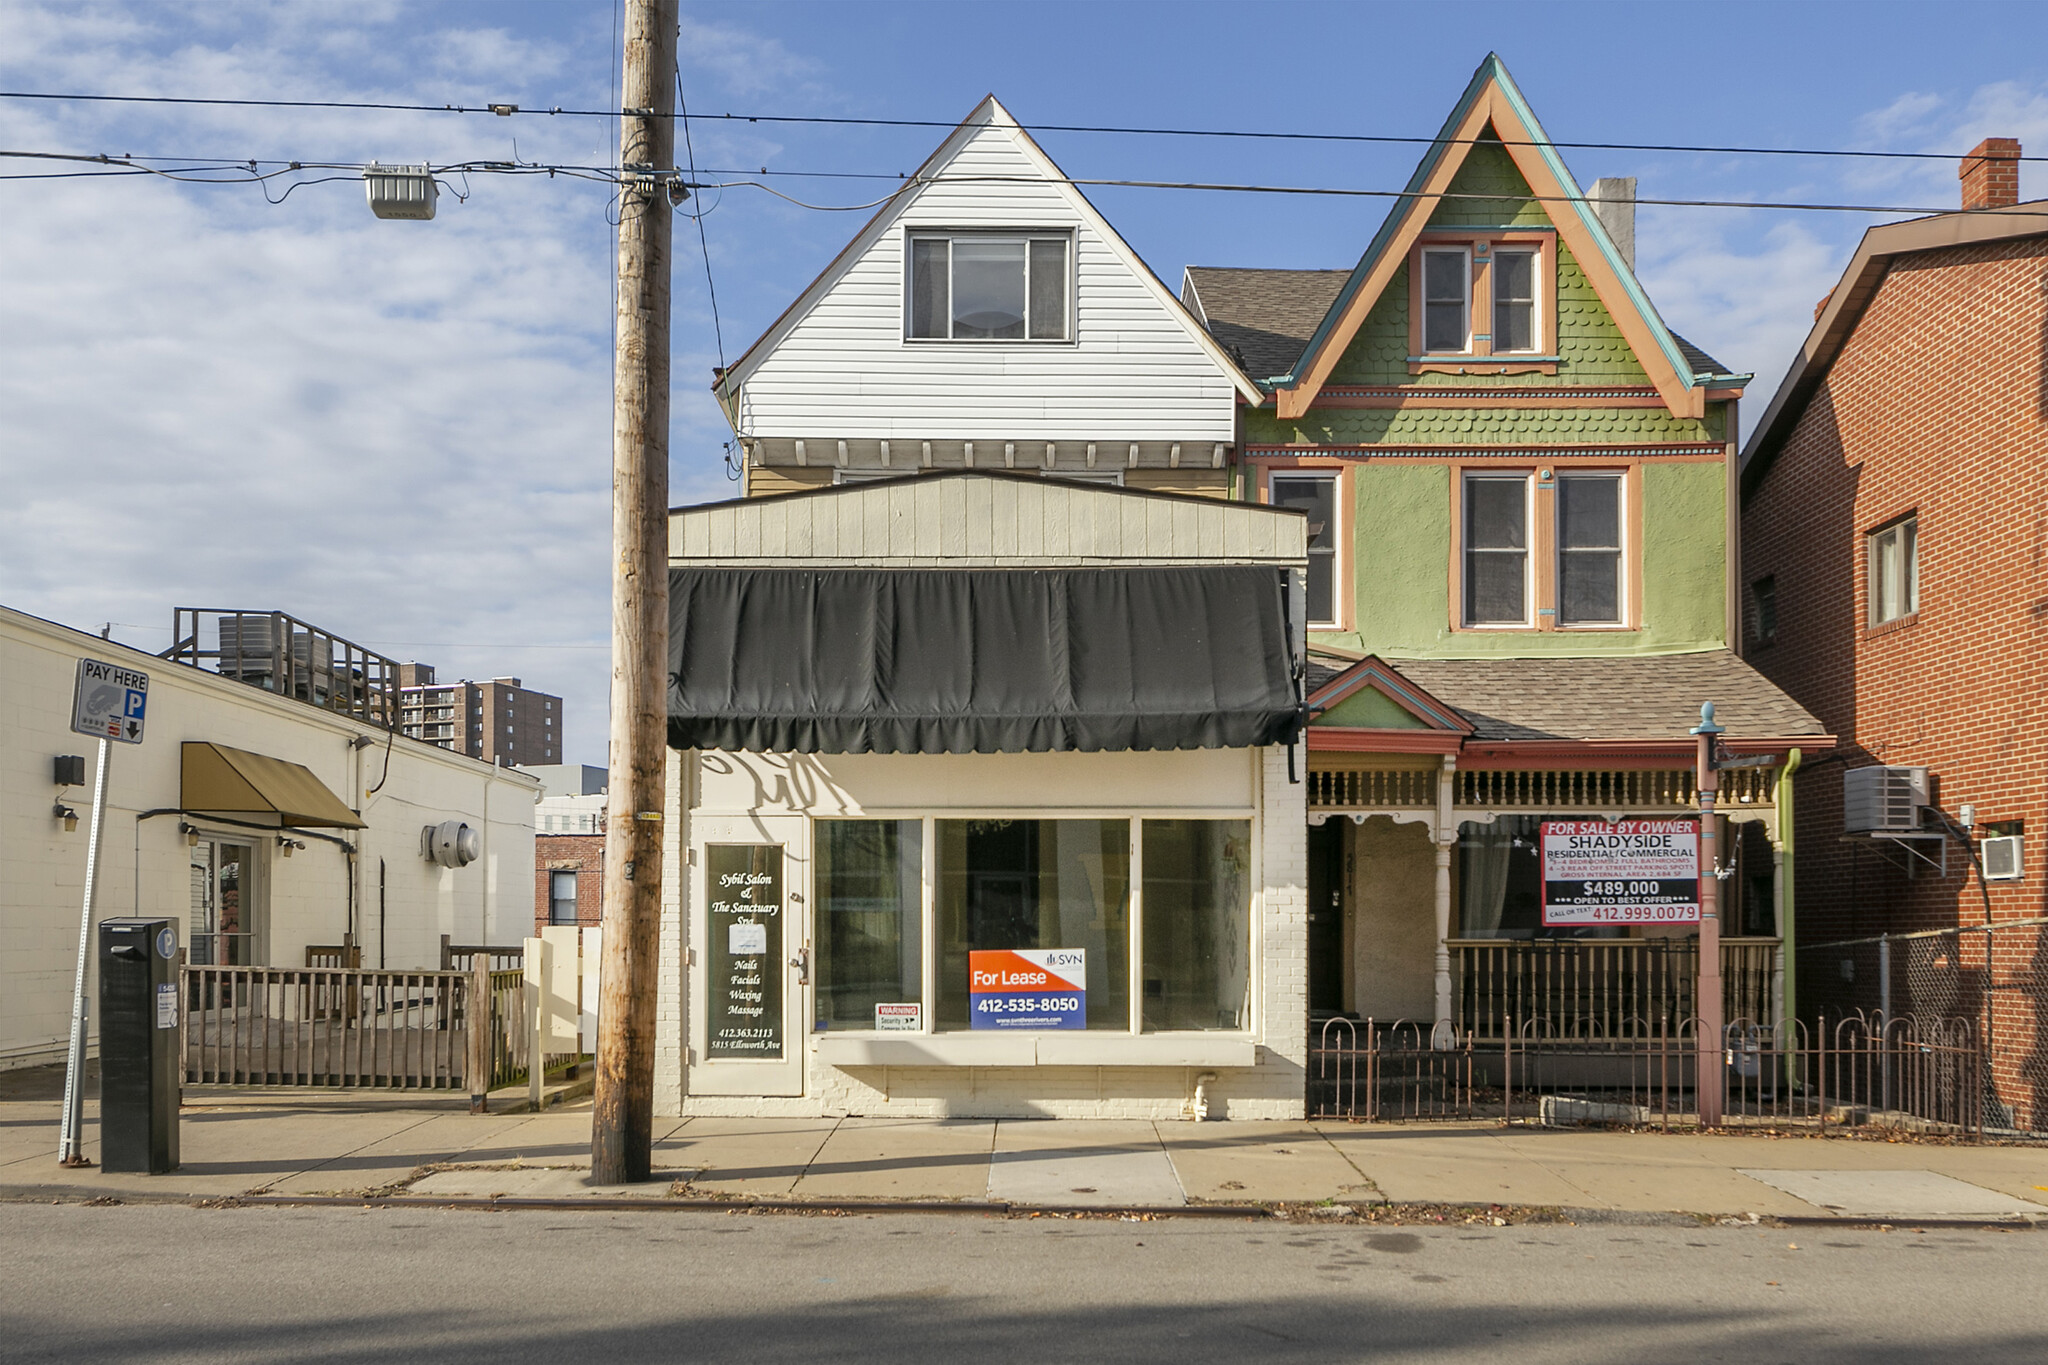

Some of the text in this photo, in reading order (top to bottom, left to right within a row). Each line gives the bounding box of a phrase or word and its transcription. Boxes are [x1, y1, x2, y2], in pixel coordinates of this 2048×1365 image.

[86, 663, 146, 690] PAY HERE
[128, 693, 143, 715] P
[1548, 821, 1692, 834] FOR SALE BY OWNER
[1569, 835, 1672, 848] SHADYSIDE
[719, 872, 772, 888] Sybil Salon
[740, 887, 752, 899] &
[1583, 881, 1659, 896] $489,000
[1618, 896, 1641, 904] BEST
[712, 901, 779, 916] The Sanctuary
[1593, 907, 1695, 920] 412.999.0079
[164, 933, 173, 954] P
[734, 960, 757, 970] Nails
[1058, 954, 1082, 965] SVN
[730, 974, 760, 985] Facials
[973, 970, 1047, 985] For Lease
[729, 989, 762, 1003] Waxing
[728, 1005, 763, 1017] Massage
[881, 1006, 917, 1015] WARNING
[978, 997, 1079, 1013] 412-535-8050
[881, 1017, 900, 1025] Security
[719, 1028, 773, 1038] 412.363.2113
[711, 1040, 781, 1050] 5815 Ellsworth Ave
